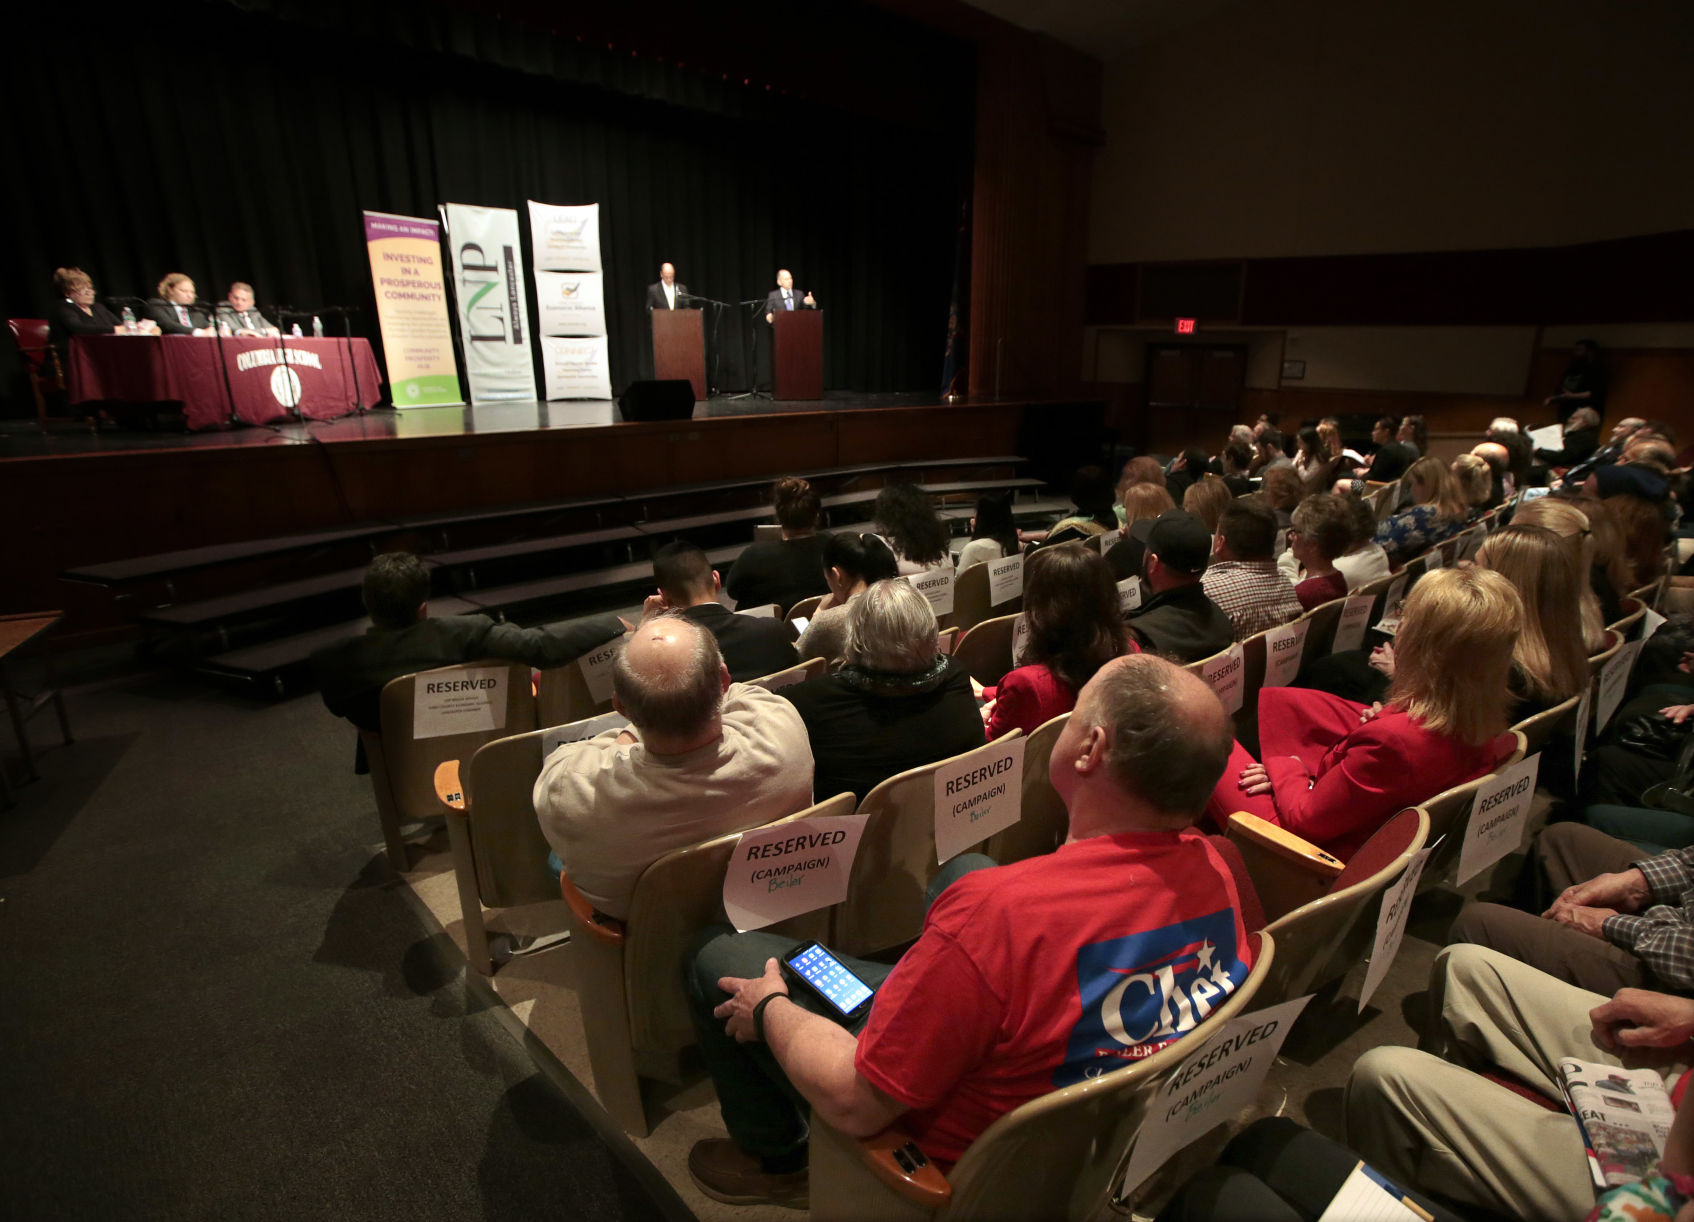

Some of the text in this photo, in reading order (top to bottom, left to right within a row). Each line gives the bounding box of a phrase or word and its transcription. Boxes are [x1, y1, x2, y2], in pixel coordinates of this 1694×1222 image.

[383, 251, 433, 265] INVESTING
[401, 266, 421, 276] IN A
[380, 276, 441, 291] PROSPEROUS
[385, 290, 441, 303] COMMUNITY
[460, 242, 507, 344] LNP
[1178, 319, 1195, 333] EXIT
[992, 562, 1020, 577] RESERVED
[916, 576, 949, 590] RESERVED
[427, 678, 497, 694] RESERVED
[946, 756, 1013, 797] RESERVED
[952, 783, 1006, 818] (CAMPAIGN)
[1478, 776, 1530, 815] RESERVED
[746, 830, 846, 861] RESERVED
[751, 857, 830, 883] (CAMPAIGN)
[1101, 959, 1236, 1046] Chet
[1168, 1020, 1279, 1097] RESERVED
[1166, 1057, 1252, 1122] (CAMPAIGN)
